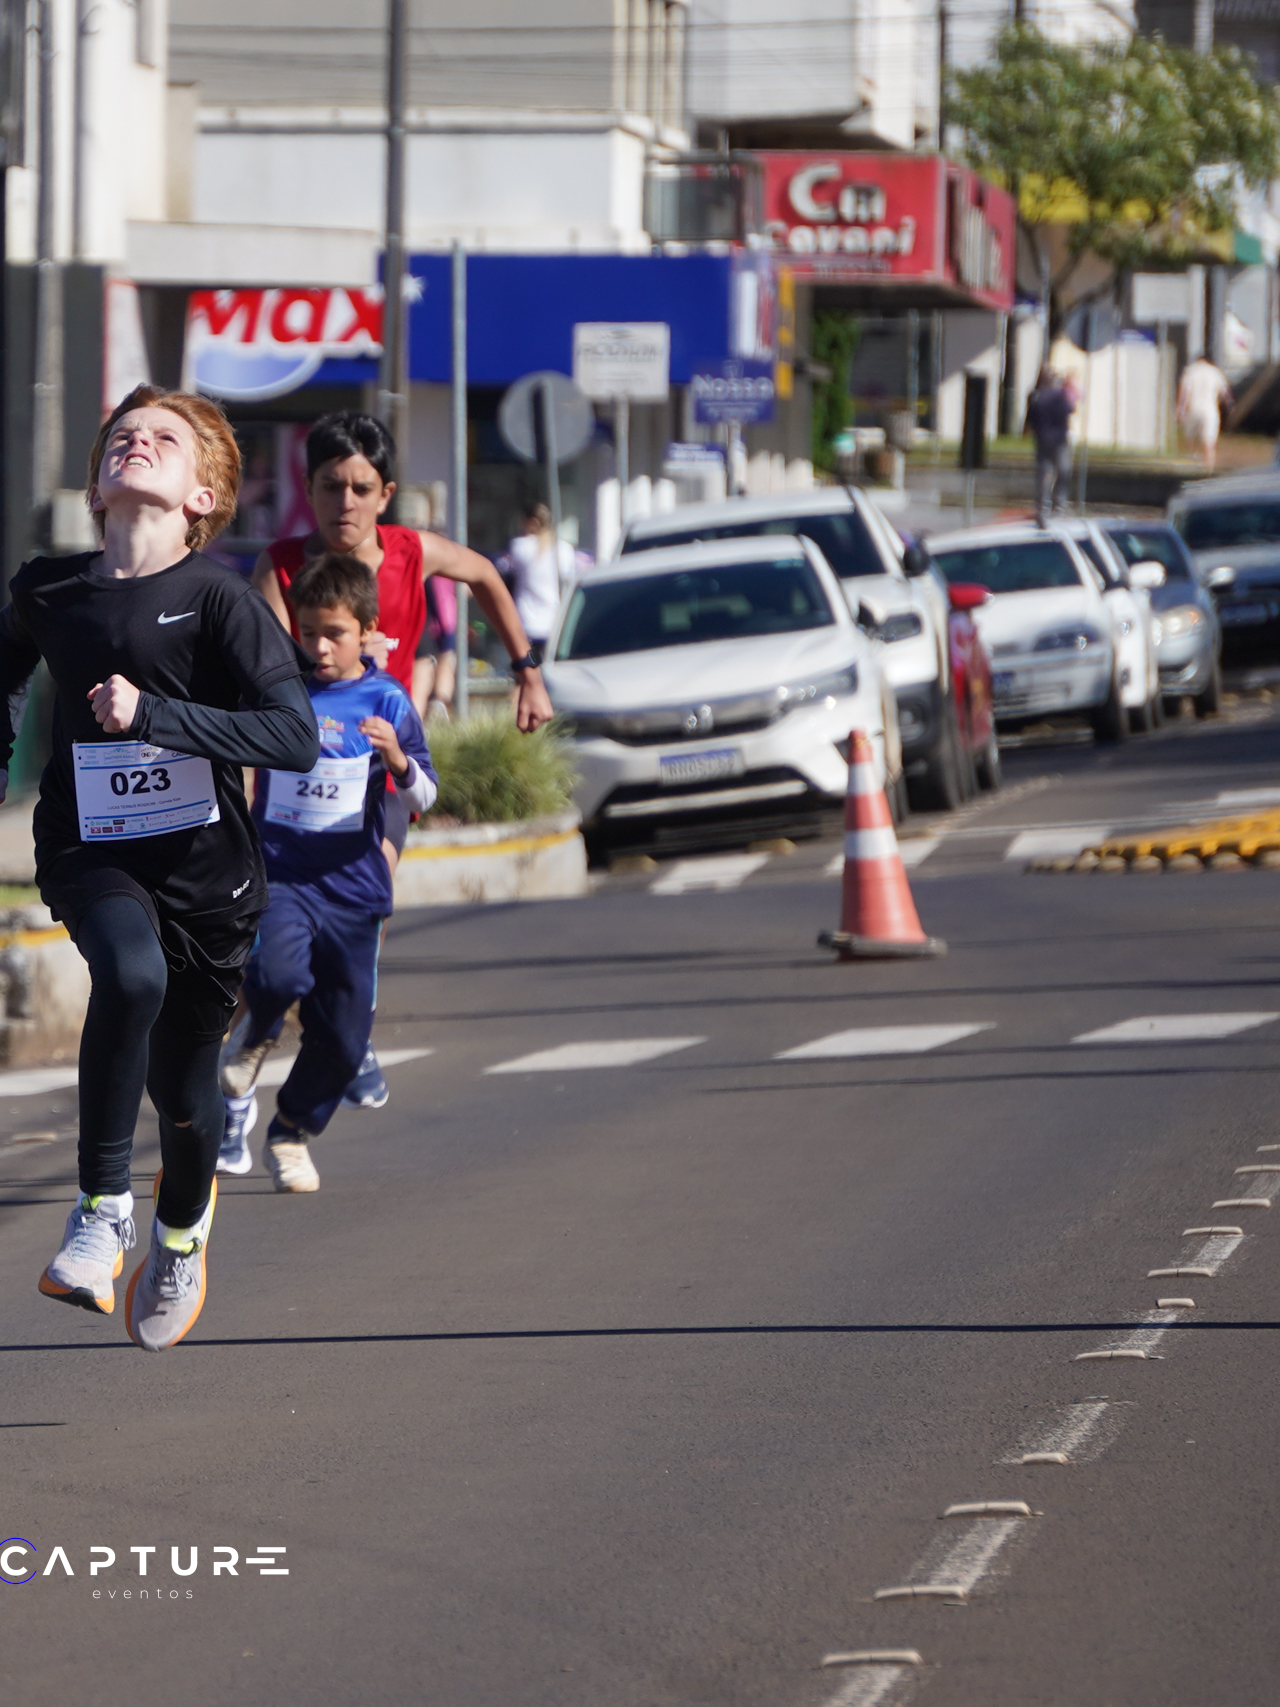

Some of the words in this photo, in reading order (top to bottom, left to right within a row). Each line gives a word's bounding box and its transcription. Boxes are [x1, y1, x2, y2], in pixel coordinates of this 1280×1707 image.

[693, 374, 774, 400] Nossa
[110, 768, 172, 796] 023
[296, 780, 339, 799] 242
